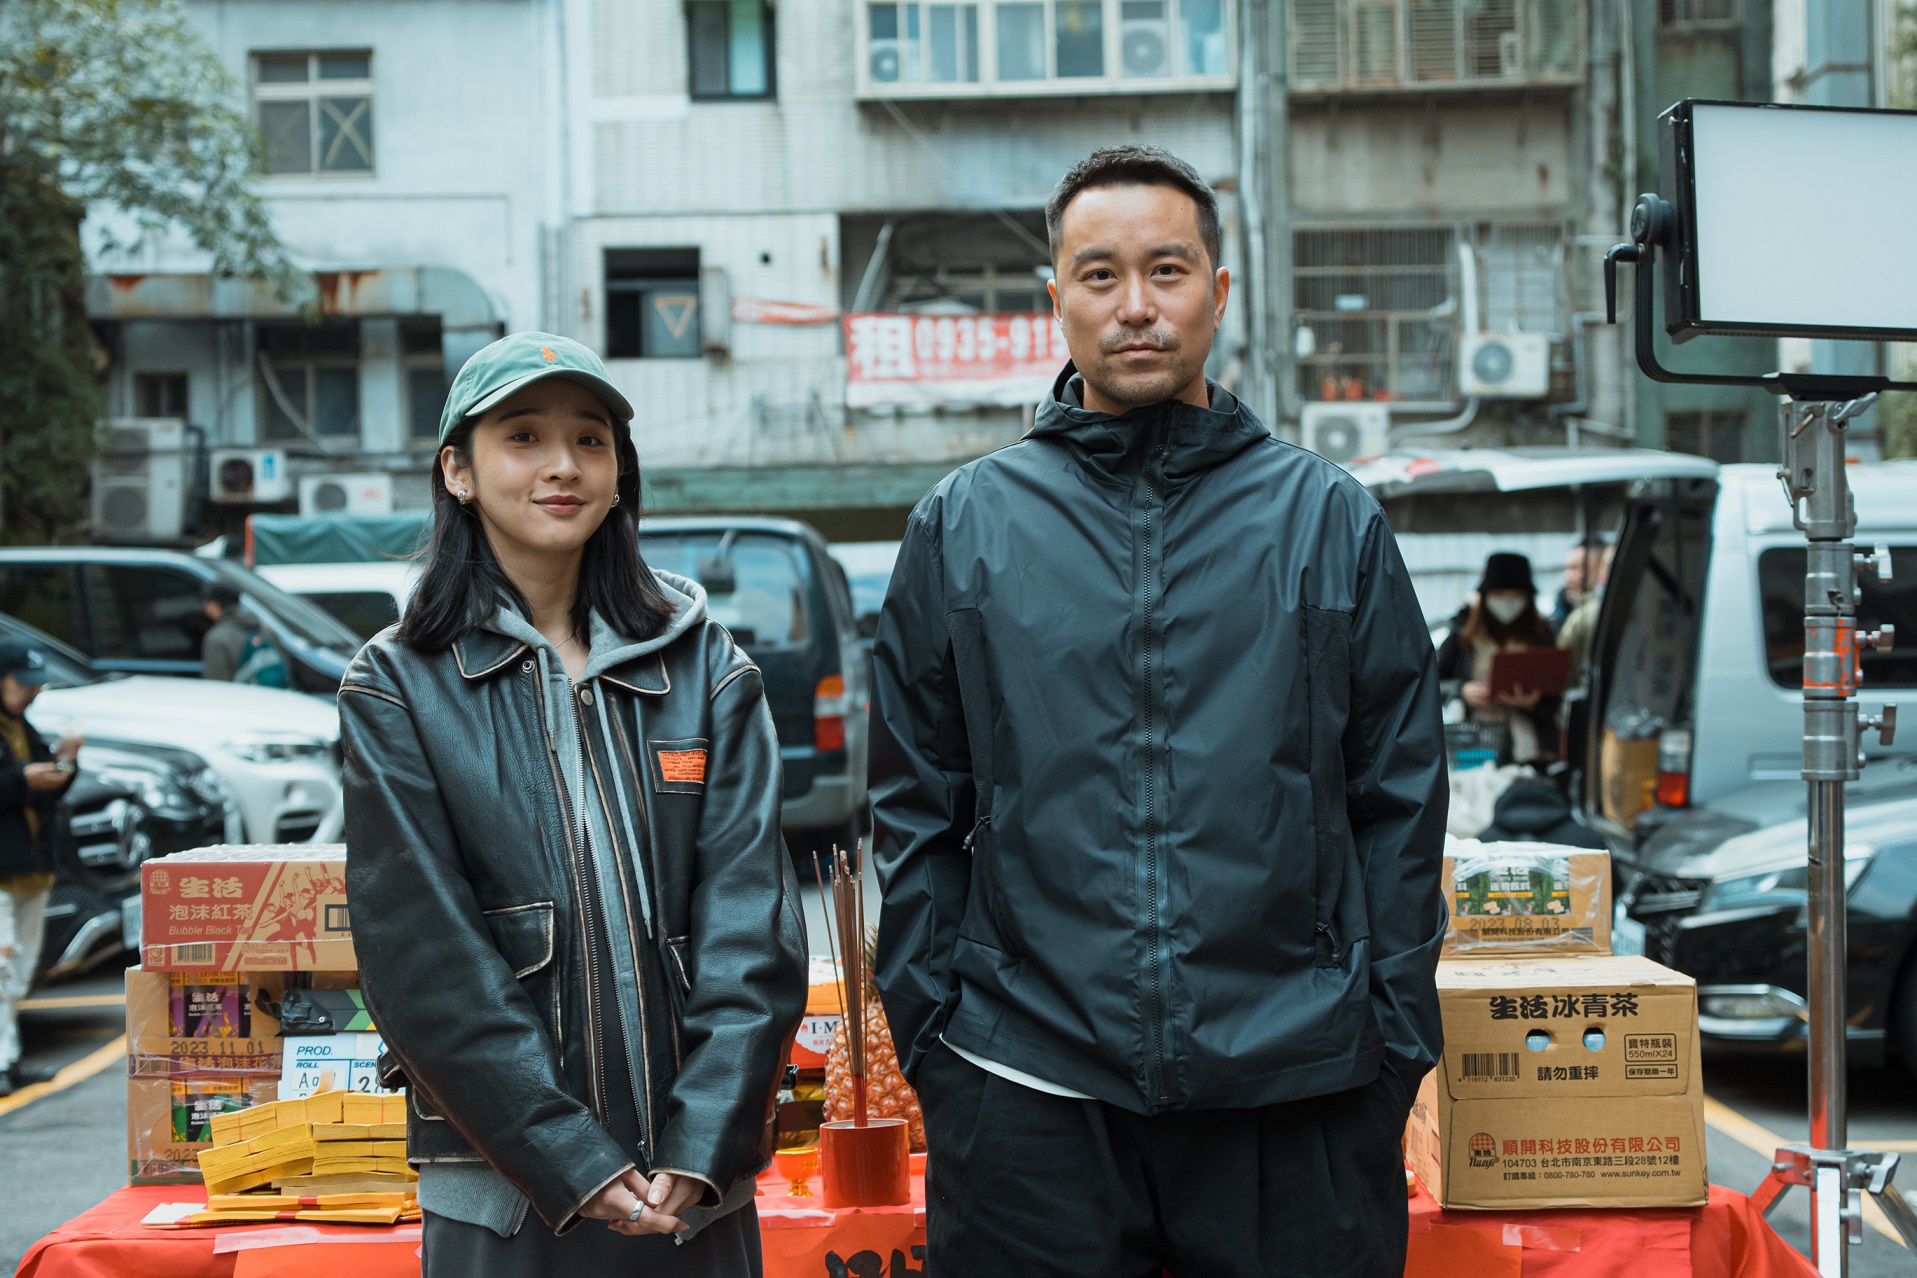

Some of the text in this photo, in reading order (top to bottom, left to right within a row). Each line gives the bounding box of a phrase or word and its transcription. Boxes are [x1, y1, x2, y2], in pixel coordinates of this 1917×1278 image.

[850, 315, 916, 378] 租
[179, 876, 243, 898] 生活
[169, 904, 254, 920] 泡沫紅茶
[169, 925, 252, 935] Bubble Black Tea
[192, 992, 219, 1002] 生活
[1489, 993, 1639, 1020] 生活冰青茶
[170, 1041, 264, 1055] 2023.11.01
[1628, 1038, 1673, 1049] 寶特瓶裝
[297, 1046, 333, 1055] PROD.
[1537, 1066, 1599, 1081] 請勿重摔
[1628, 1067, 1675, 1076] 保存期限一年
[1502, 1137, 1681, 1156] 順開科技股份有限公司
[1503, 1159, 1537, 1168] 104703
[1601, 1170, 1681, 1178] www.sunkey.com.tw
